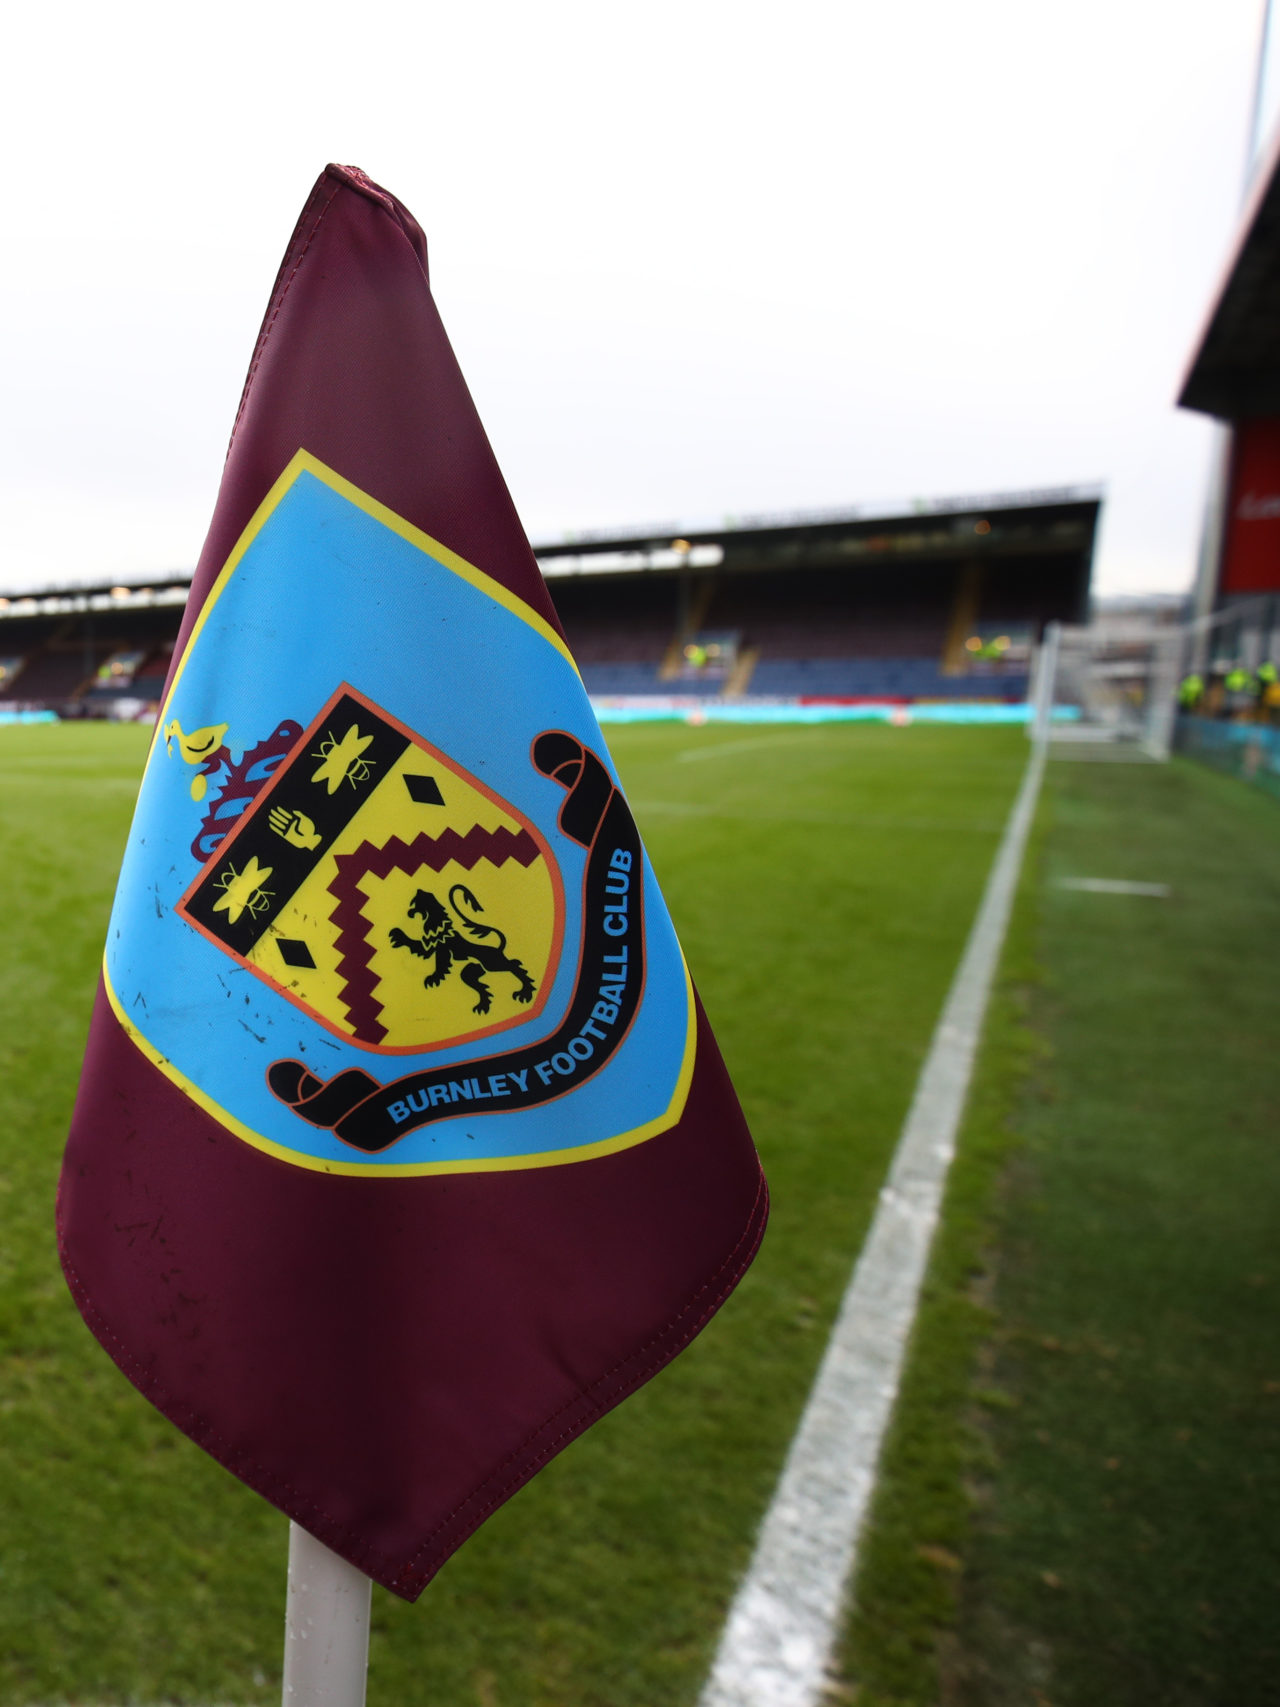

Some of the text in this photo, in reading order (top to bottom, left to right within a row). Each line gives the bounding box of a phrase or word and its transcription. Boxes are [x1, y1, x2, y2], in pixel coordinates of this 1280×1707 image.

[387, 848, 632, 1124] BURNLEY FOOTBALL CLUB
